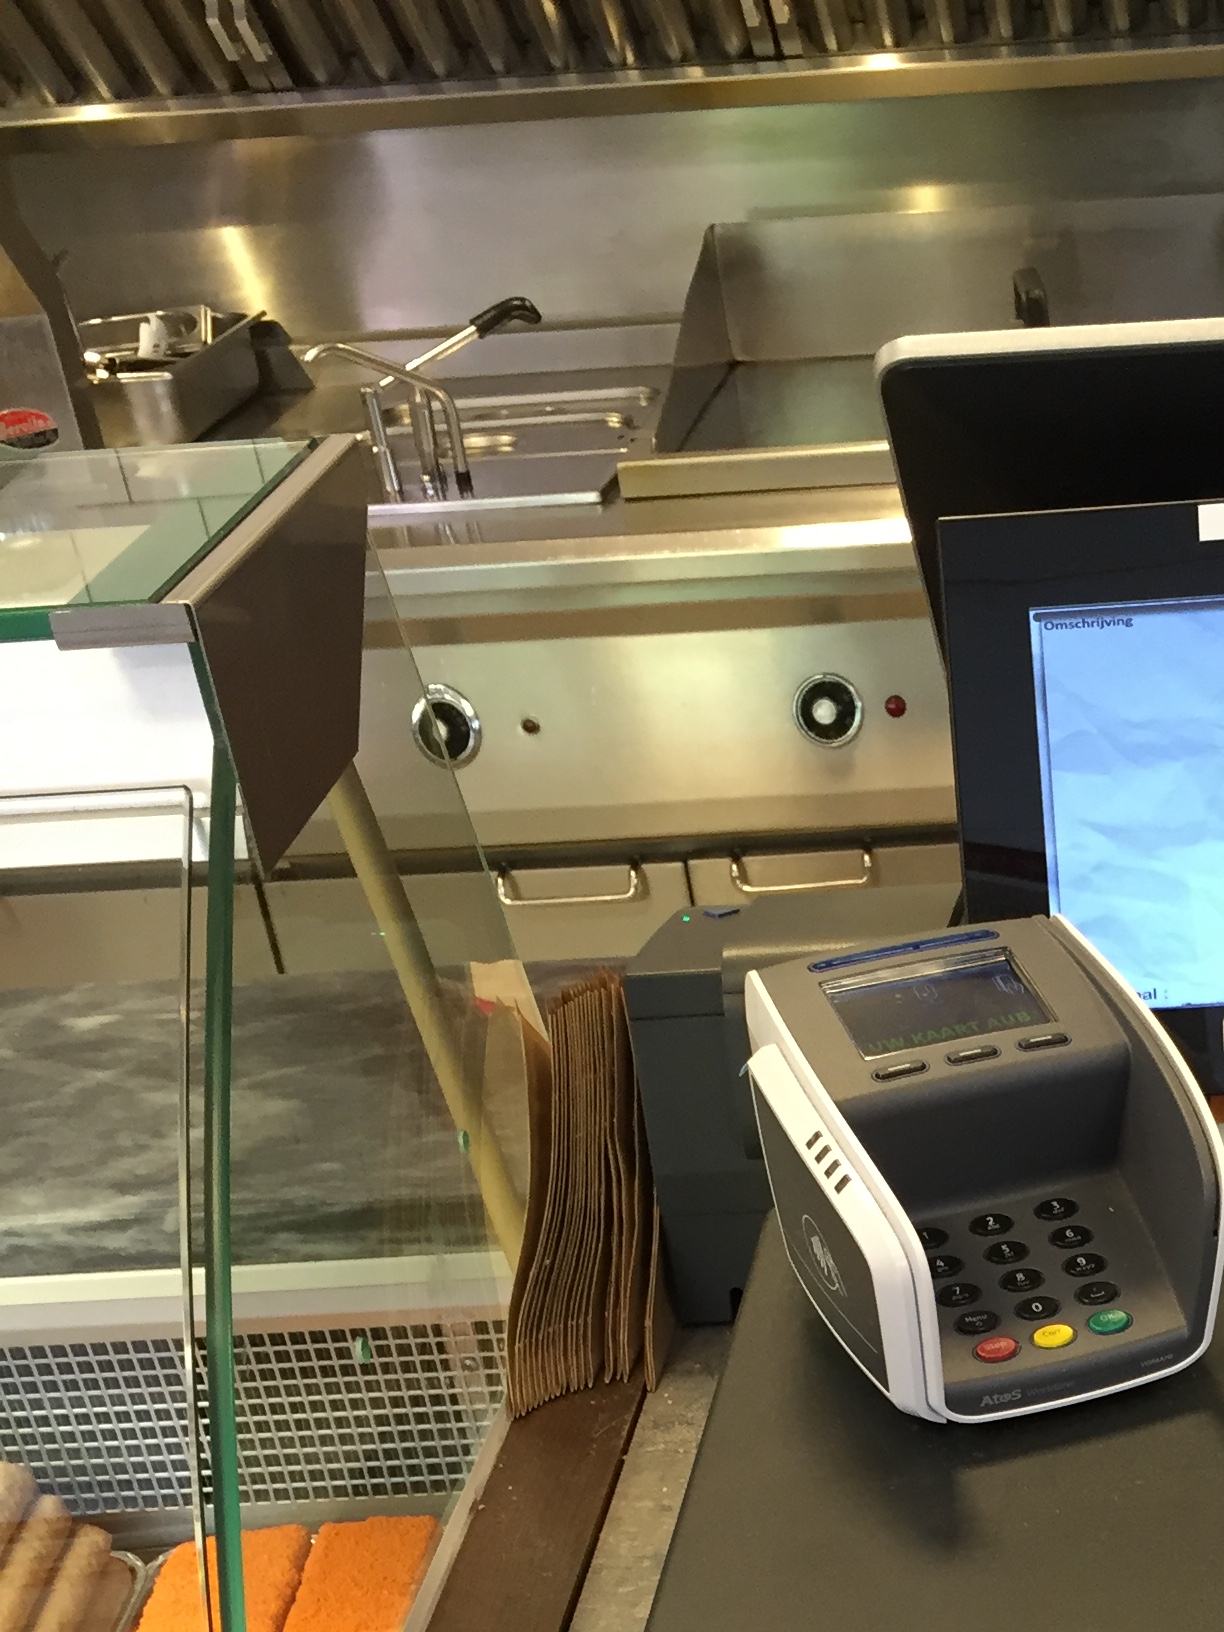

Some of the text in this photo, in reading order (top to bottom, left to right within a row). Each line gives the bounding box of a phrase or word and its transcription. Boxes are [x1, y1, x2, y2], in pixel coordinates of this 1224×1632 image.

[1043, 615, 1134, 632] Omschrijving
[868, 1011, 1032, 1052] UW KAART AUB
[986, 1216, 995, 1226] 2
[1051, 1201, 1060, 1209] 3
[936, 1229, 1075, 1267] 4 5 6
[952, 1257, 1086, 1295] 7 8 9
[964, 1314, 988, 1324] Menu
[1031, 1302, 1043, 1312] 0
